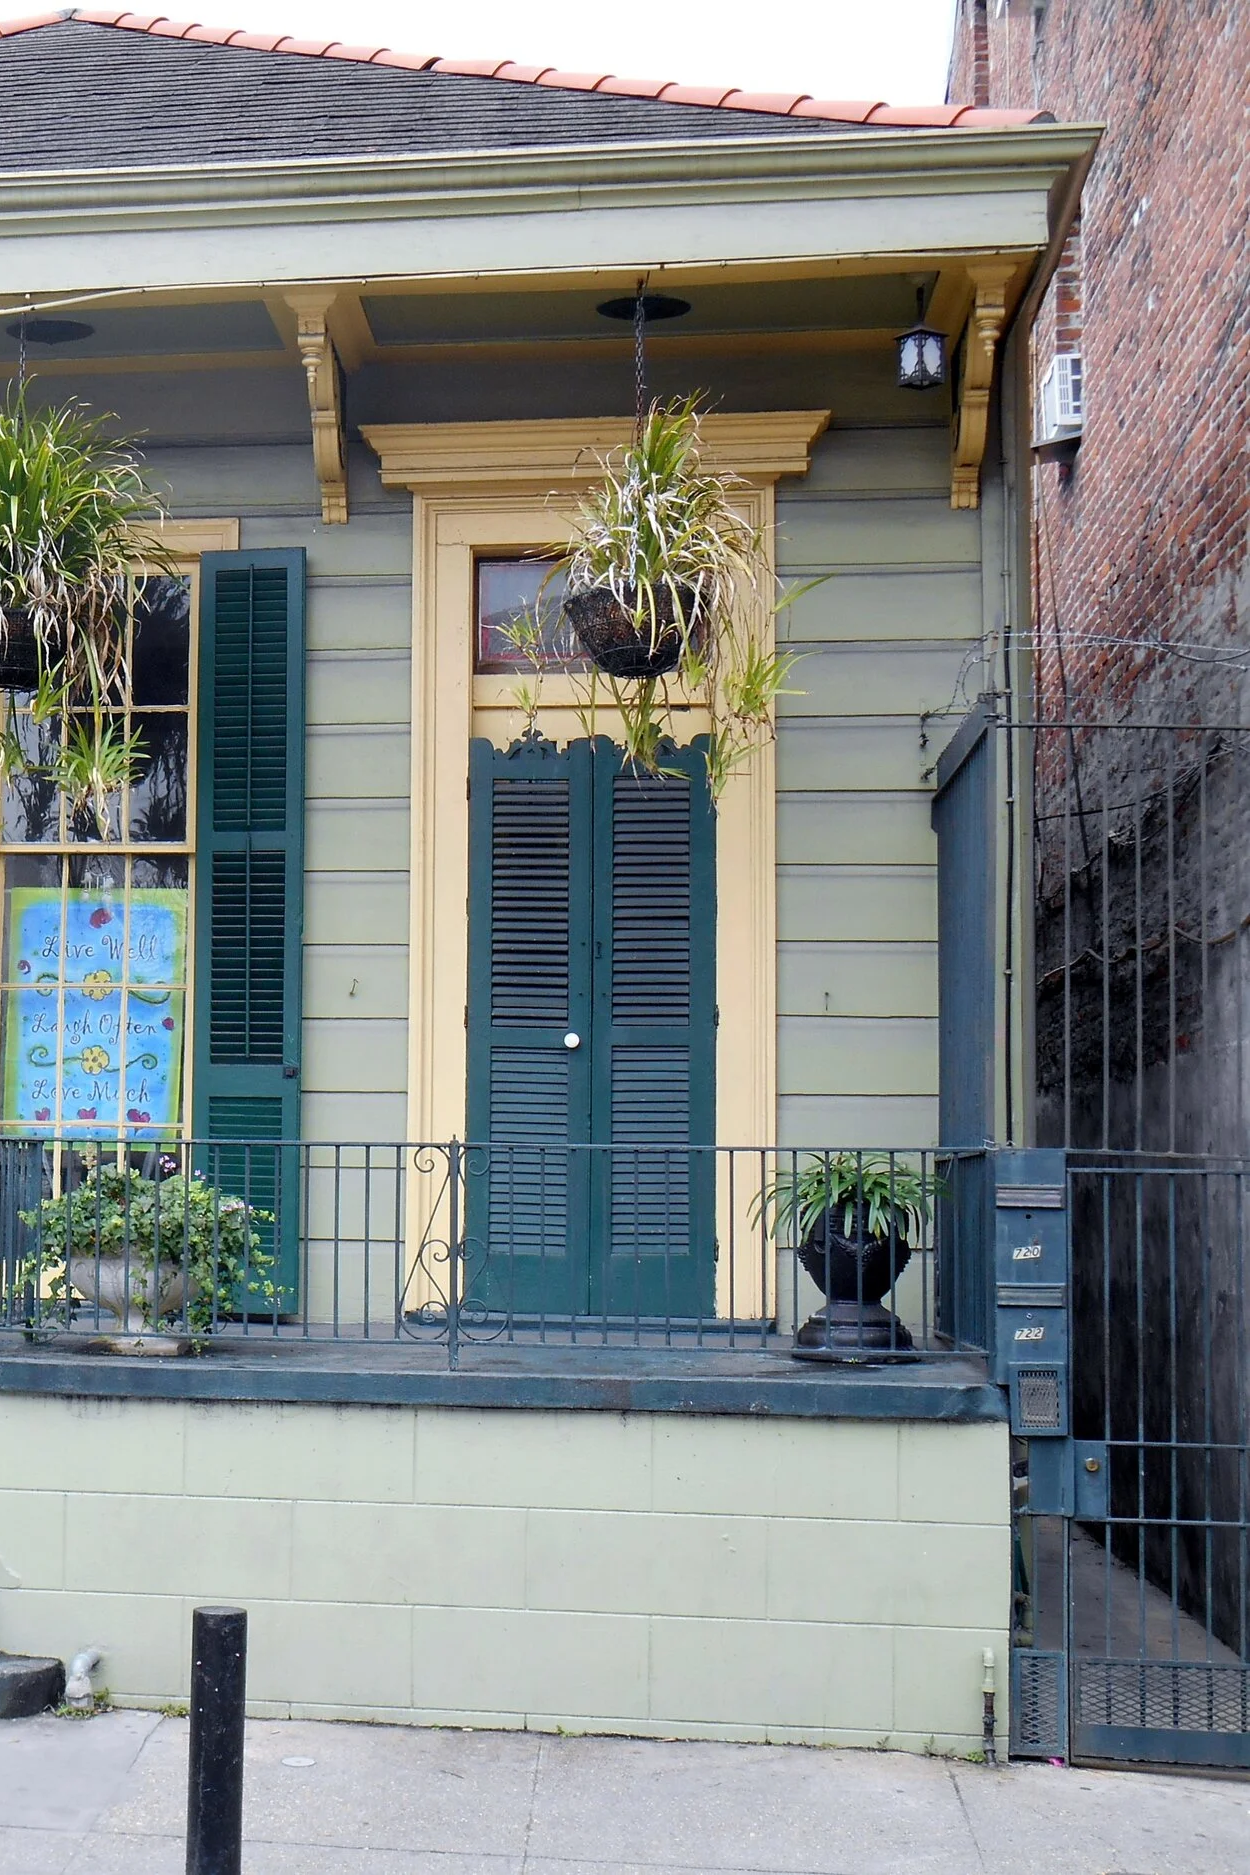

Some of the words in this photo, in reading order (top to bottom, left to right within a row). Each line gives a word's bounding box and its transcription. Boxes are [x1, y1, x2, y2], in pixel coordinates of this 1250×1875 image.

[42, 935, 95, 959] Live
[101, 934, 158, 961] Well
[99, 1013, 158, 1045] Often
[31, 1079, 82, 1100] Love
[1014, 1246, 1041, 1259] 720
[1016, 1327, 1043, 1339] 722
